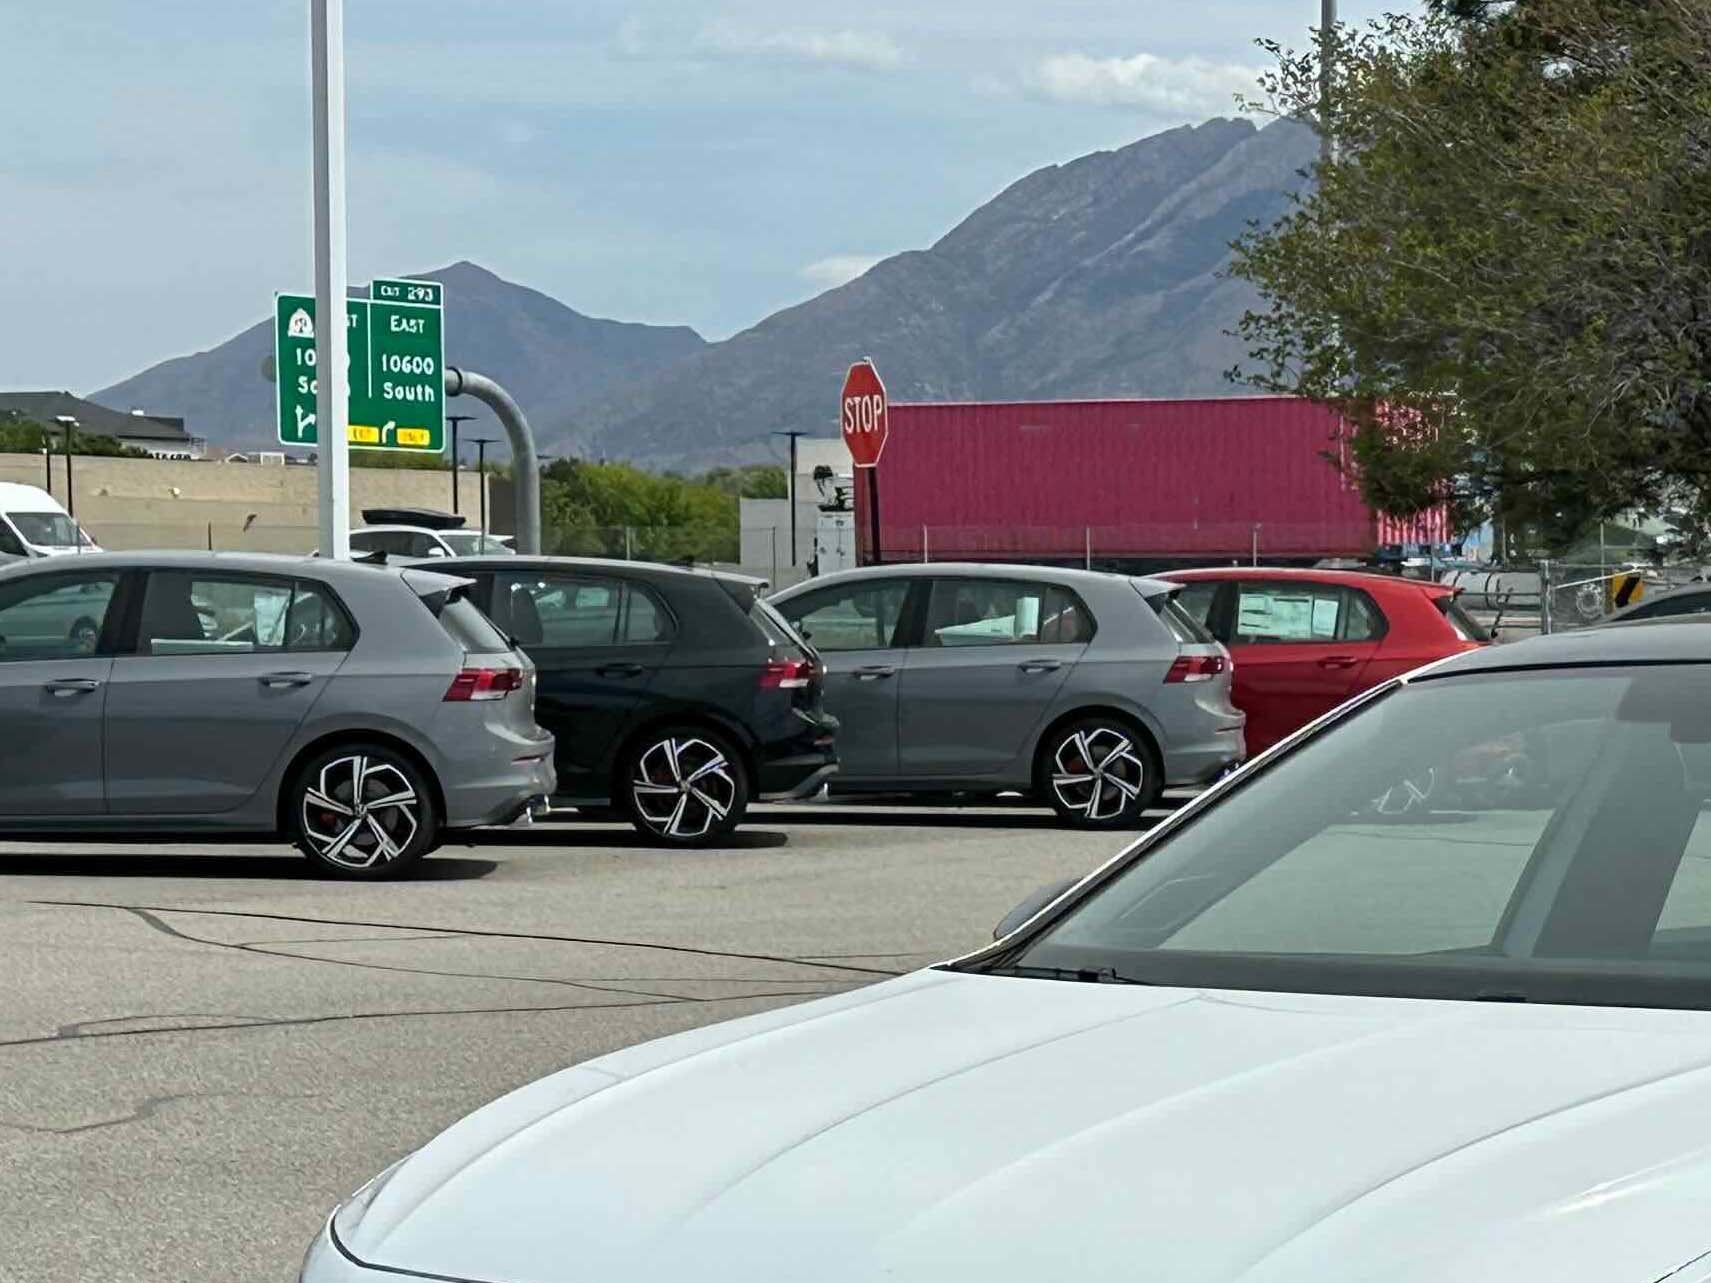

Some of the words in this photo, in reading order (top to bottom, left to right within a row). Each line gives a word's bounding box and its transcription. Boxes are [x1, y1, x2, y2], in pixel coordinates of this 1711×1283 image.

[407, 286, 434, 302] 293
[390, 315, 425, 333] EAST
[382, 354, 434, 375] 10600
[383, 382, 435, 402] South
[844, 395, 883, 434] STOP
